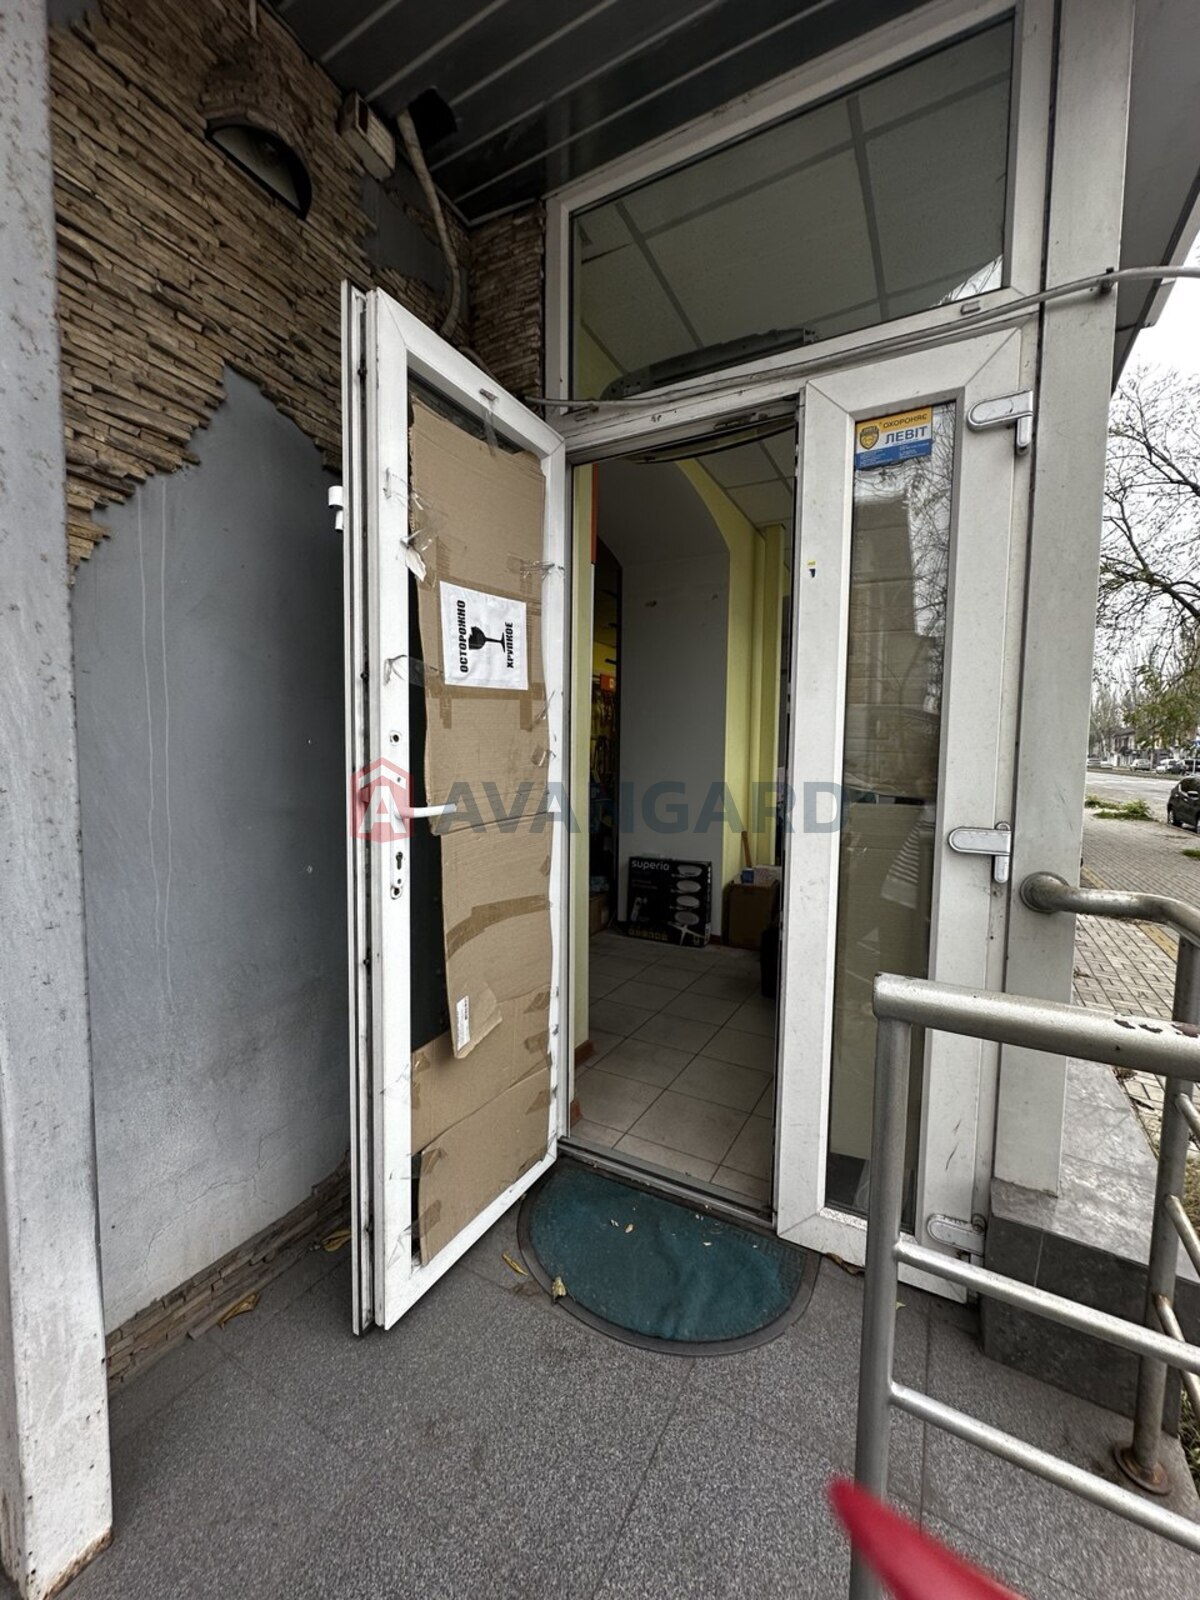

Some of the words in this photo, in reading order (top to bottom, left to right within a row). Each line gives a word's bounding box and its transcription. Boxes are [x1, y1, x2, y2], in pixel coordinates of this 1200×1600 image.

[885, 426, 928, 444] ЛЕВІТ
[457, 600, 469, 673] ОСТОРОЖНО
[505, 621, 514, 669] ХРУПКОЕ
